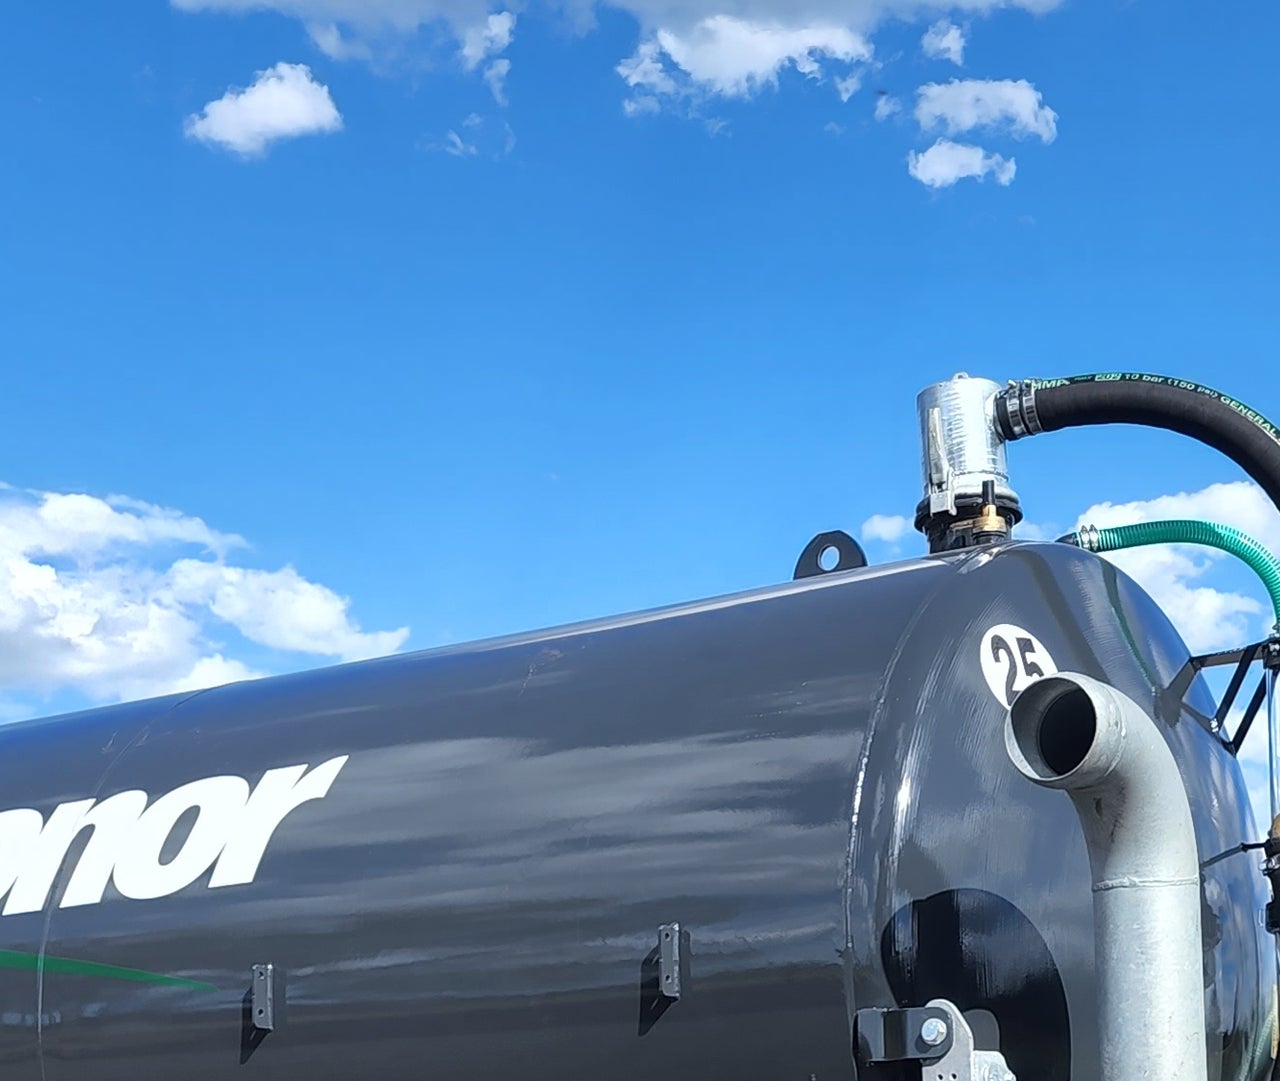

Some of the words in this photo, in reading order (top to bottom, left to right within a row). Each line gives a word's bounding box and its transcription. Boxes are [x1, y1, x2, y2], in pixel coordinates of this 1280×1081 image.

[1142, 374, 1166, 383] bar
[1220, 396, 1277, 437] GENERAL
[990, 634, 1045, 707] 25
